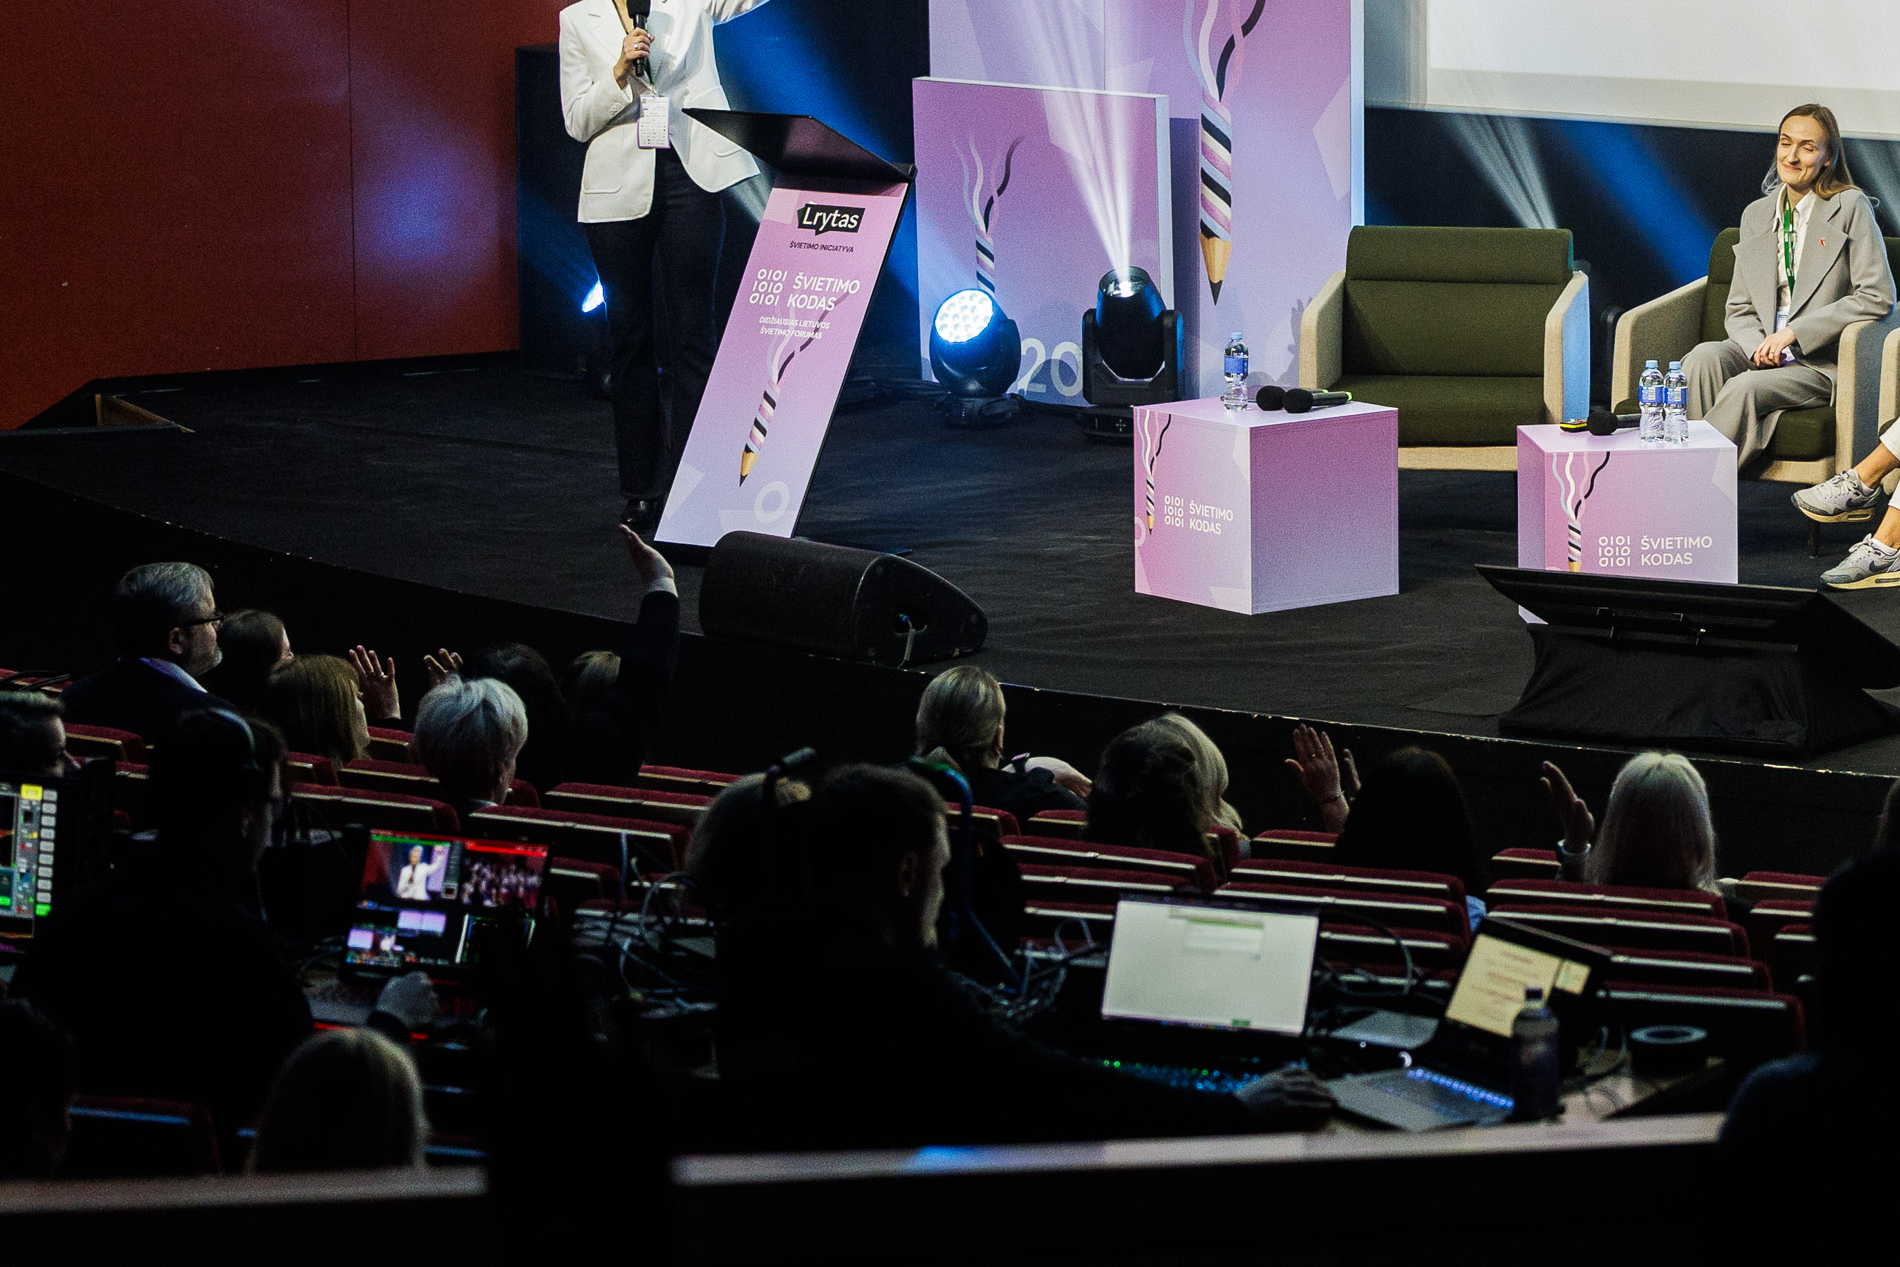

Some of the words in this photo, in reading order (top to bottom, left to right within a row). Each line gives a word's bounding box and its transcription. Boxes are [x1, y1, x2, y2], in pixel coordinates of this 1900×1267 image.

[802, 207, 860, 231] Lrytas
[789, 240, 819, 250] ŠVIETIMO
[820, 243, 854, 252] INICIATYVA
[792, 272, 860, 294] ŠVIETIMO
[787, 294, 837, 311] KODAS
[759, 316, 798, 326] DIDŽIAUSIAS
[799, 320, 831, 329] LIETUVOS
[1189, 500, 1234, 522] ŠVIETIMO
[1189, 518, 1222, 535] KODAS
[1640, 534, 1713, 551] ŠVIETIMO
[1641, 552, 1693, 566] KODAS
